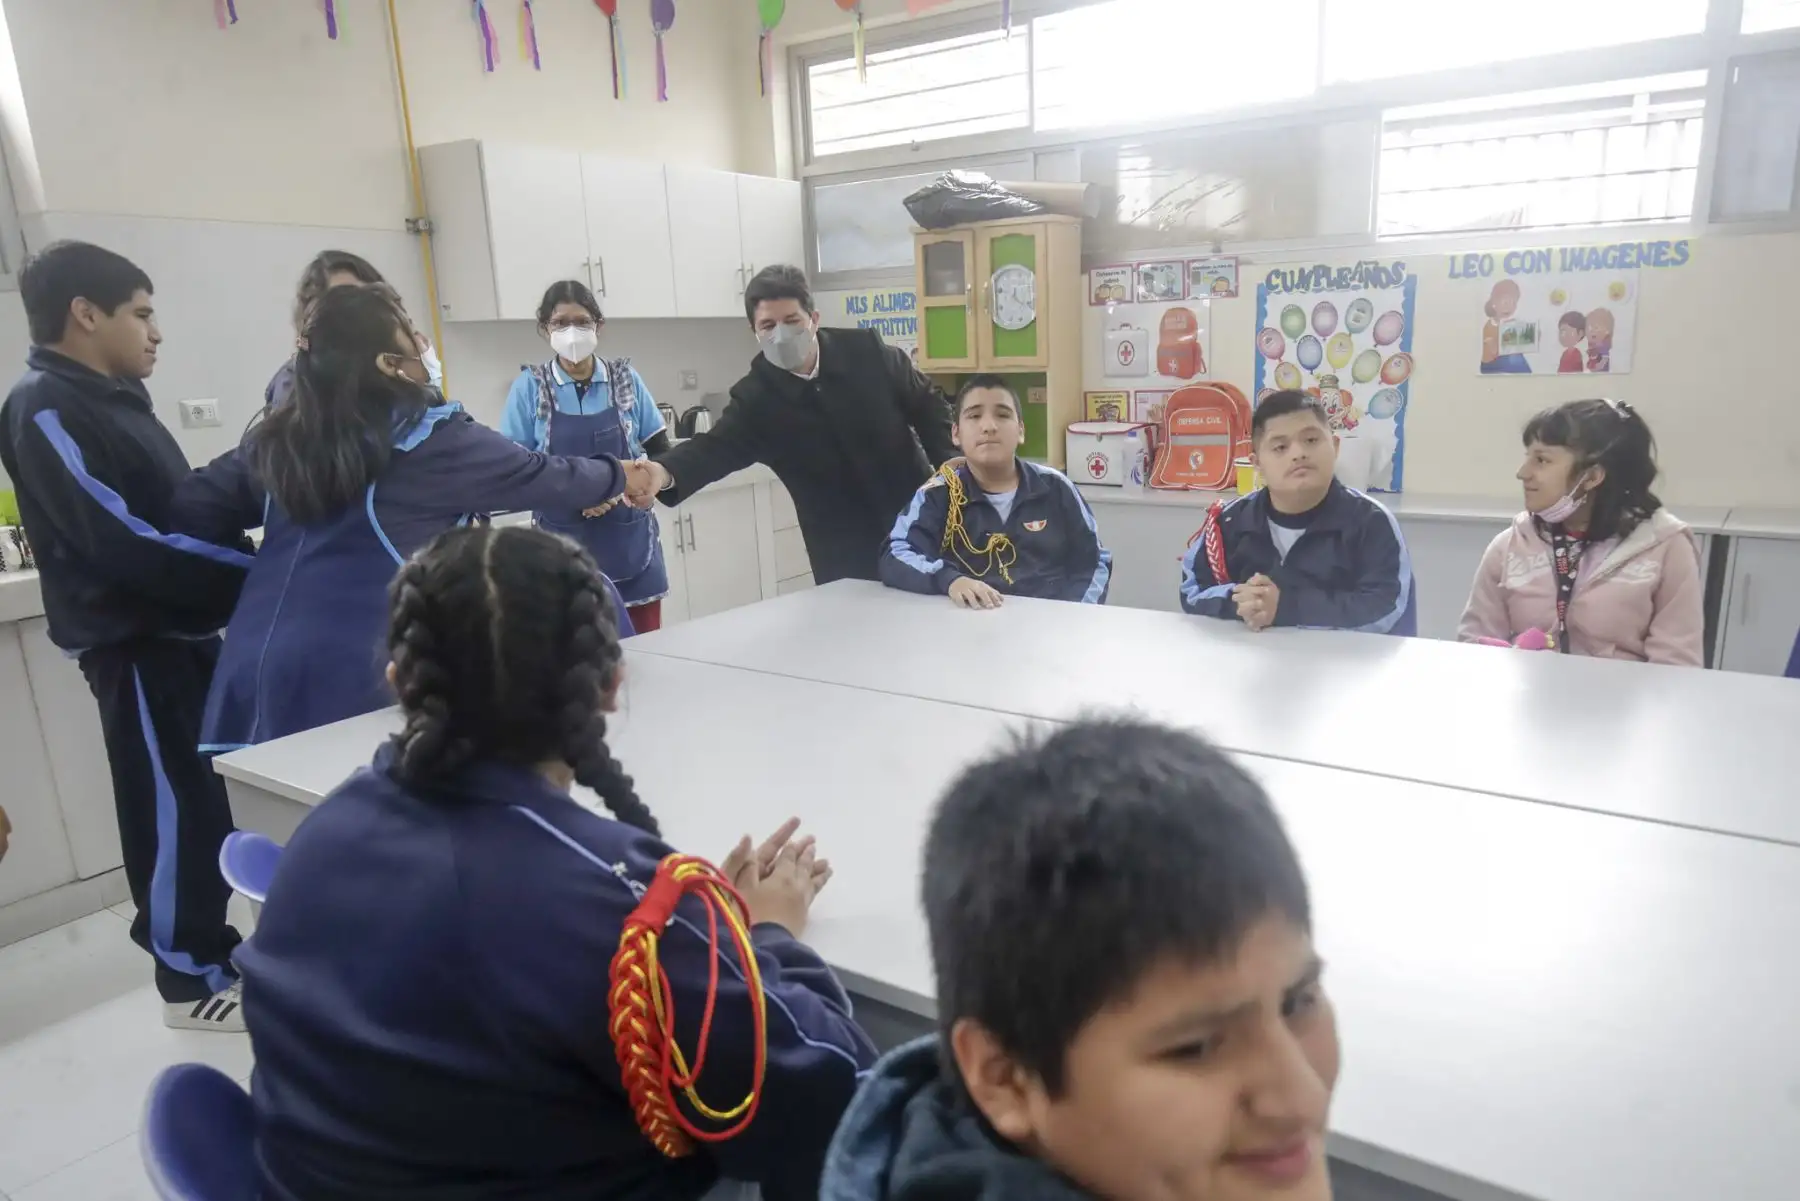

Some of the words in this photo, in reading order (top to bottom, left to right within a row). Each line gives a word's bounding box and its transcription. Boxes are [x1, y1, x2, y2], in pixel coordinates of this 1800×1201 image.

[1448, 253, 1494, 279] LEO
[1503, 247, 1551, 275] CON
[1560, 240, 1690, 273] IMAGENES
[1265, 260, 1406, 293] CUMPLEAÑOS
[846, 295, 868, 315] MIS
[1206, 416, 1222, 424] CIVIL
